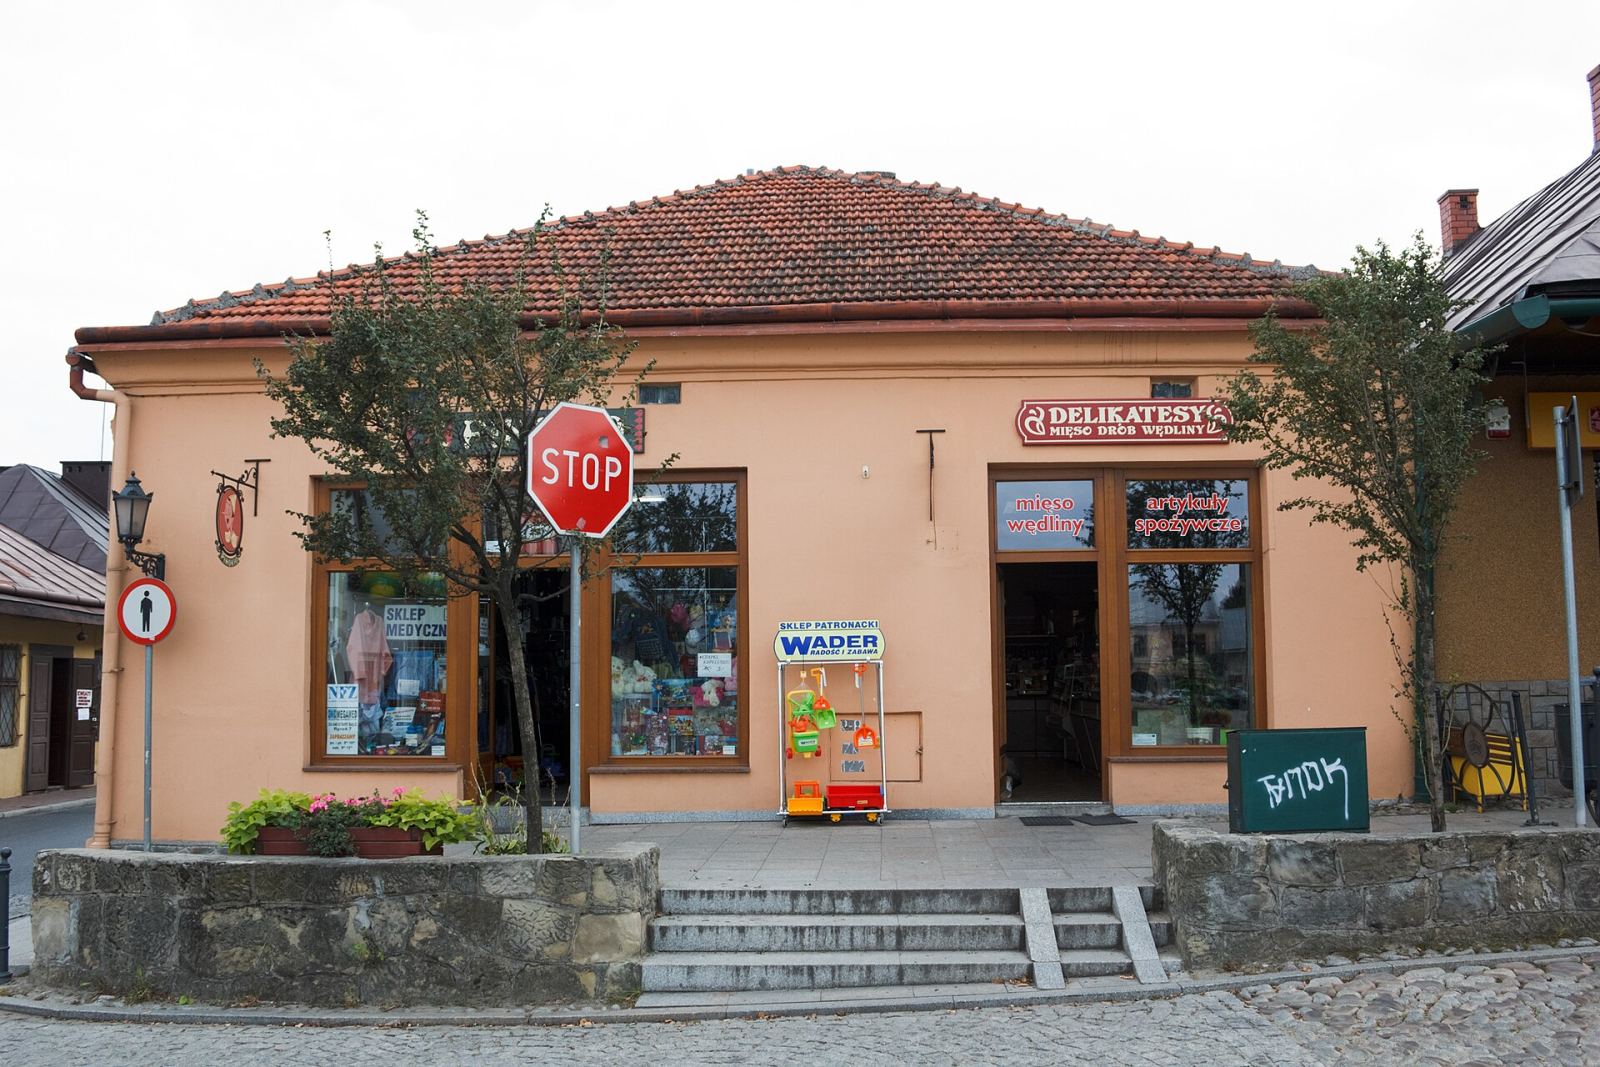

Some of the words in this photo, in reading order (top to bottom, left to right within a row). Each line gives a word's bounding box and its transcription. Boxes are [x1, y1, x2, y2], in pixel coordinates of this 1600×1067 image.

[1048, 405, 1208, 424] DELIKATESY
[1049, 425, 1092, 438] MIĘSO
[1097, 422, 1136, 436] DRÓB
[1142, 424, 1206, 438] WĘDLINY
[541, 447, 622, 492] STOP
[1015, 493, 1074, 514] mięso
[1146, 492, 1229, 515] artykuły
[1006, 514, 1084, 536] wędliny
[1134, 514, 1241, 536] spożywcze
[386, 607, 426, 621] SKLEP
[780, 622, 812, 630] SKLEP
[815, 620, 878, 629] PATRONACKI
[780, 635, 878, 656] WADER
[810, 648, 840, 656] RADOŚĆ
